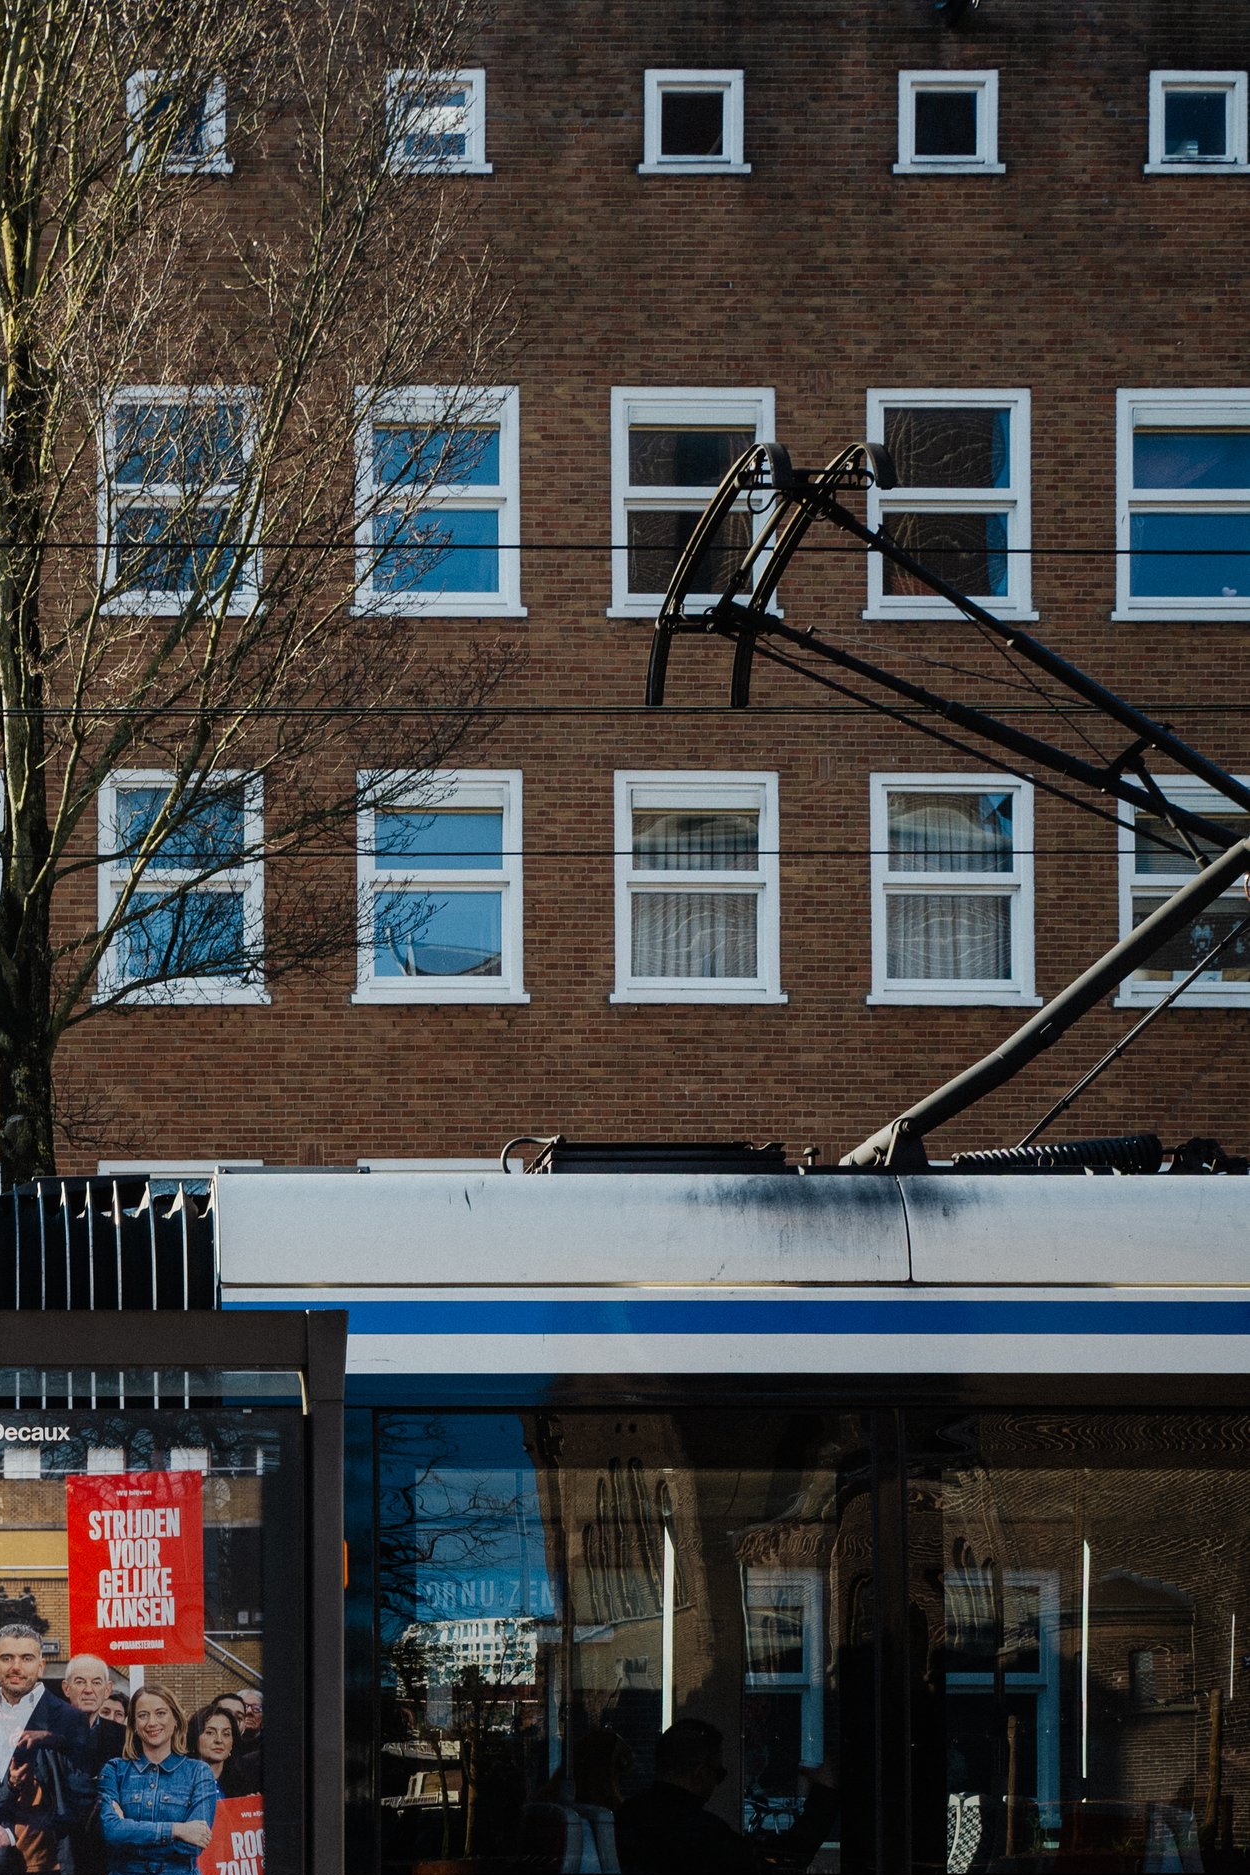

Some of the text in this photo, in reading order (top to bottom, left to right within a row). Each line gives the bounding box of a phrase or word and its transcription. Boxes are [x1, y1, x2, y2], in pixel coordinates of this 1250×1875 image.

[129, 1489, 152, 1497] blijven
[88, 1507, 181, 1541] STRIJDEN
[108, 1538, 161, 1569] VOOR
[99, 1567, 173, 1599] GELIJKE
[97, 1597, 175, 1629] KANSEN
